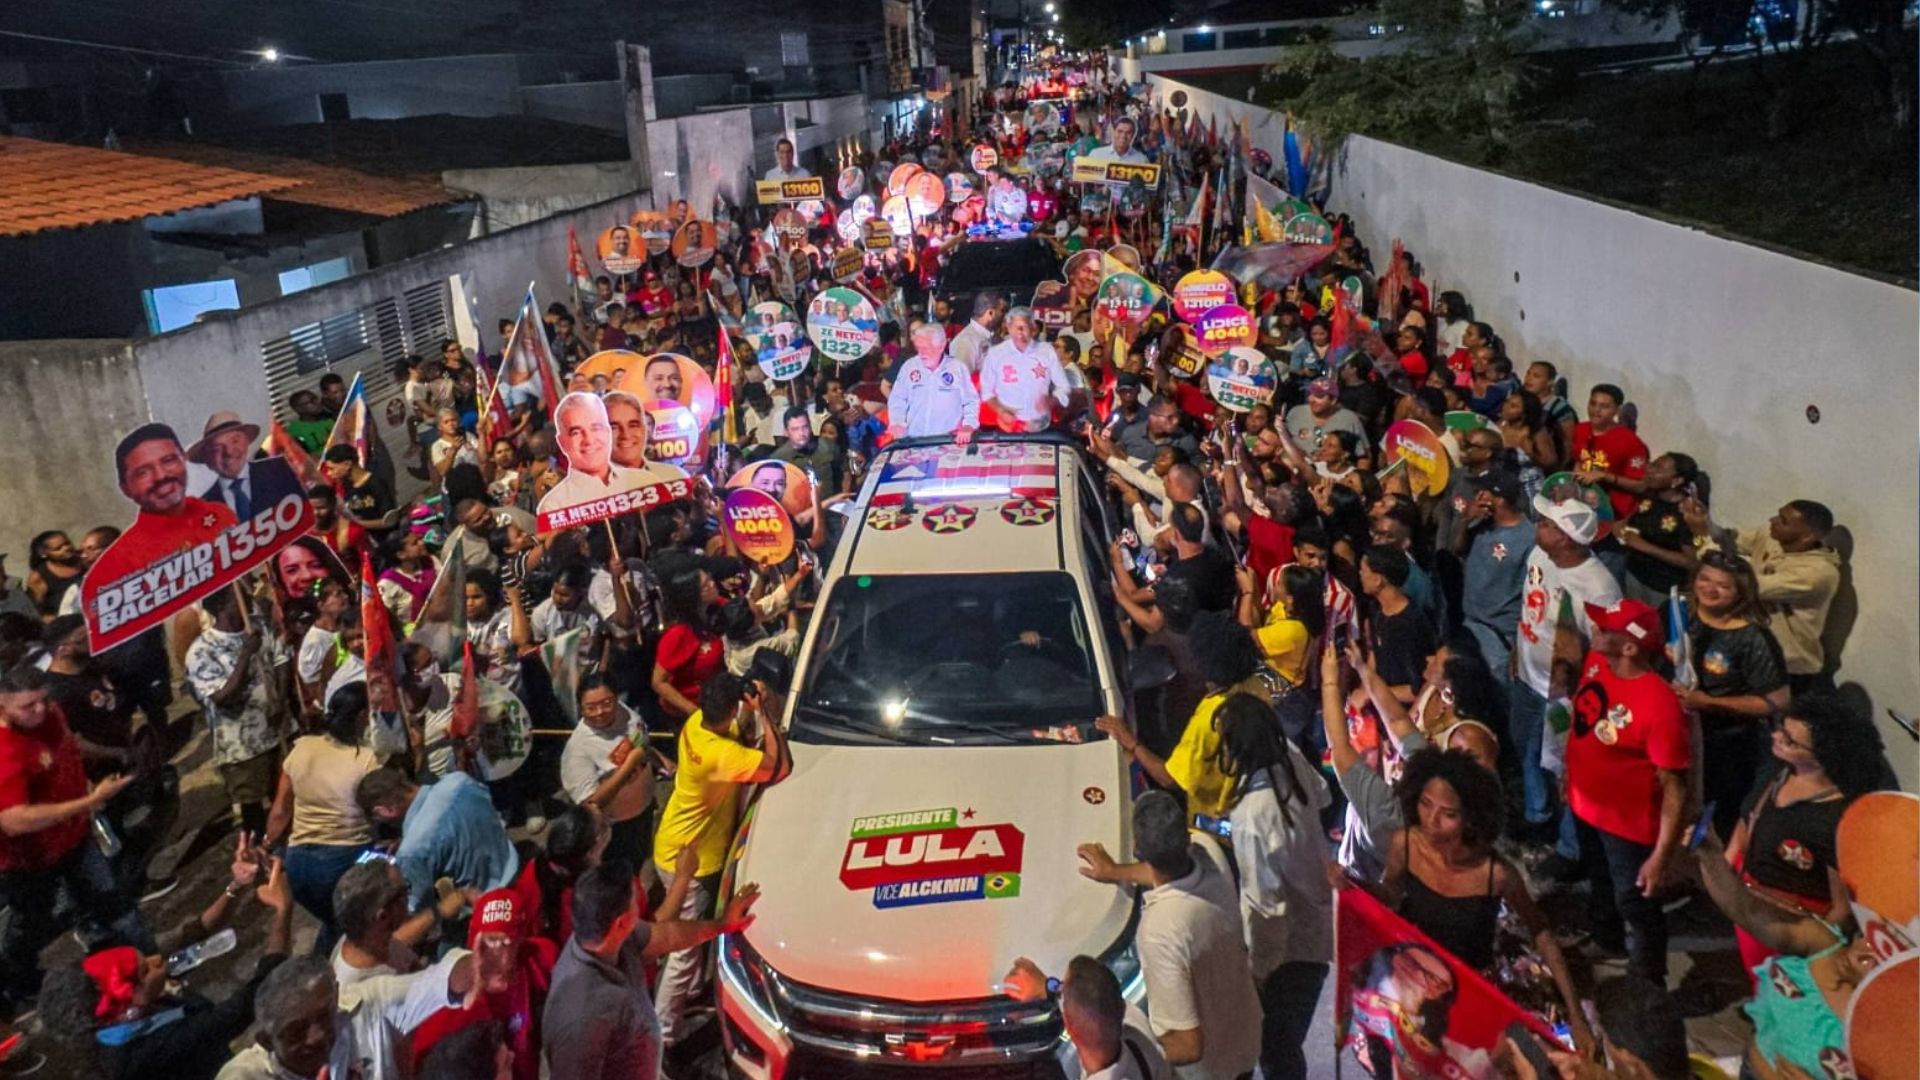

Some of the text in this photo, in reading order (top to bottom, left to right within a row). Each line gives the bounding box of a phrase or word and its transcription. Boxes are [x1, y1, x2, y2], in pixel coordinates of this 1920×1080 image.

[783, 182, 819, 197] 13100
[1203, 325, 1250, 340] 4040
[820, 338, 863, 357] 1323
[773, 361, 803, 378] 1323
[568, 499, 608, 520] NETO
[606, 486, 660, 515] 1323
[735, 518, 783, 534] 4040
[97, 541, 214, 614] DEYVID
[214, 493, 304, 570] 1350
[99, 561, 215, 635] BACELAR
[853, 807, 953, 833] PRESIDENTE
[846, 829, 1006, 871] LULA
[876, 875, 980, 902] VICE ALCKMIN
[481, 911, 513, 925] NIMO
